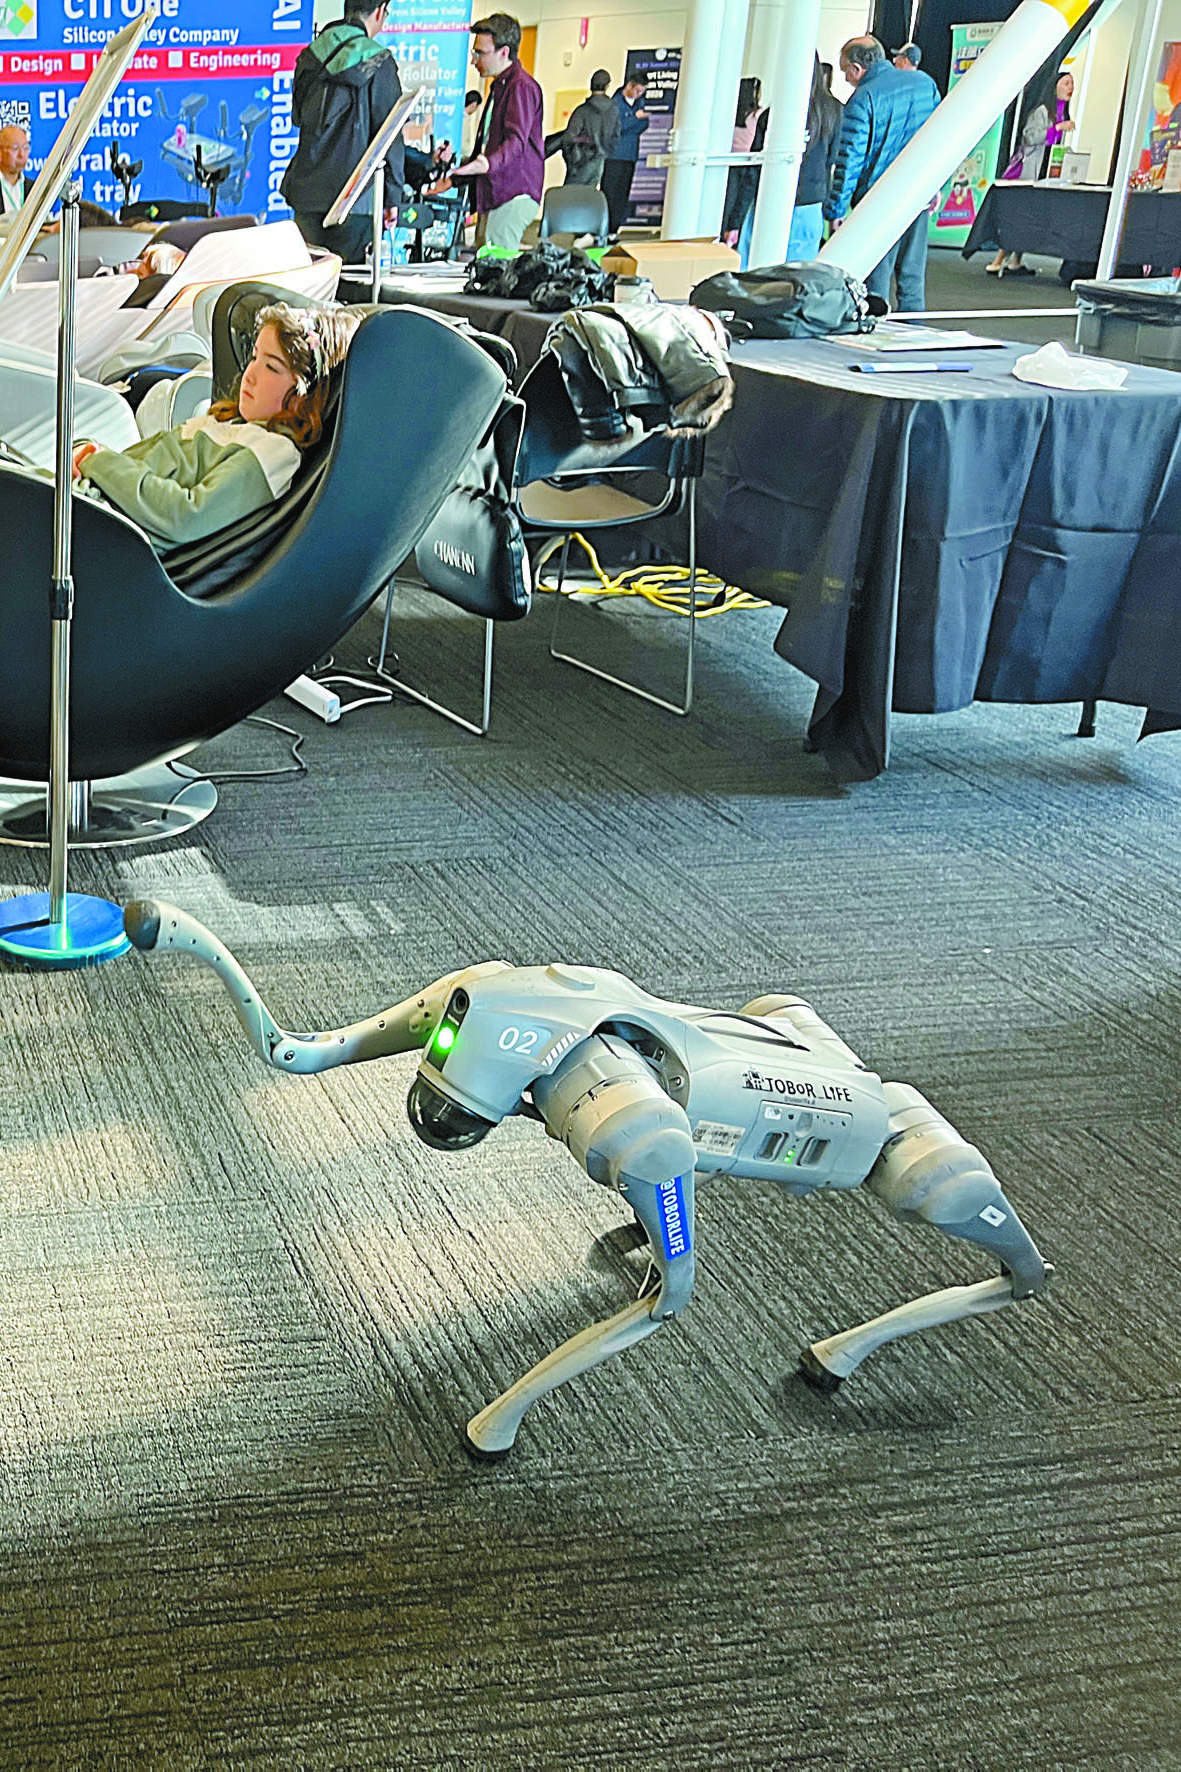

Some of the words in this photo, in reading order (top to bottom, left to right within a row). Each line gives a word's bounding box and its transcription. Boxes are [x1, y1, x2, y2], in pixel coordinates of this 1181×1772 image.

[62, 27, 116, 44] Silicon
[168, 28, 239, 46] Company
[10, 55, 64, 76] Design
[189, 50, 282, 72] Engineering
[498, 1026, 539, 1055] 02
